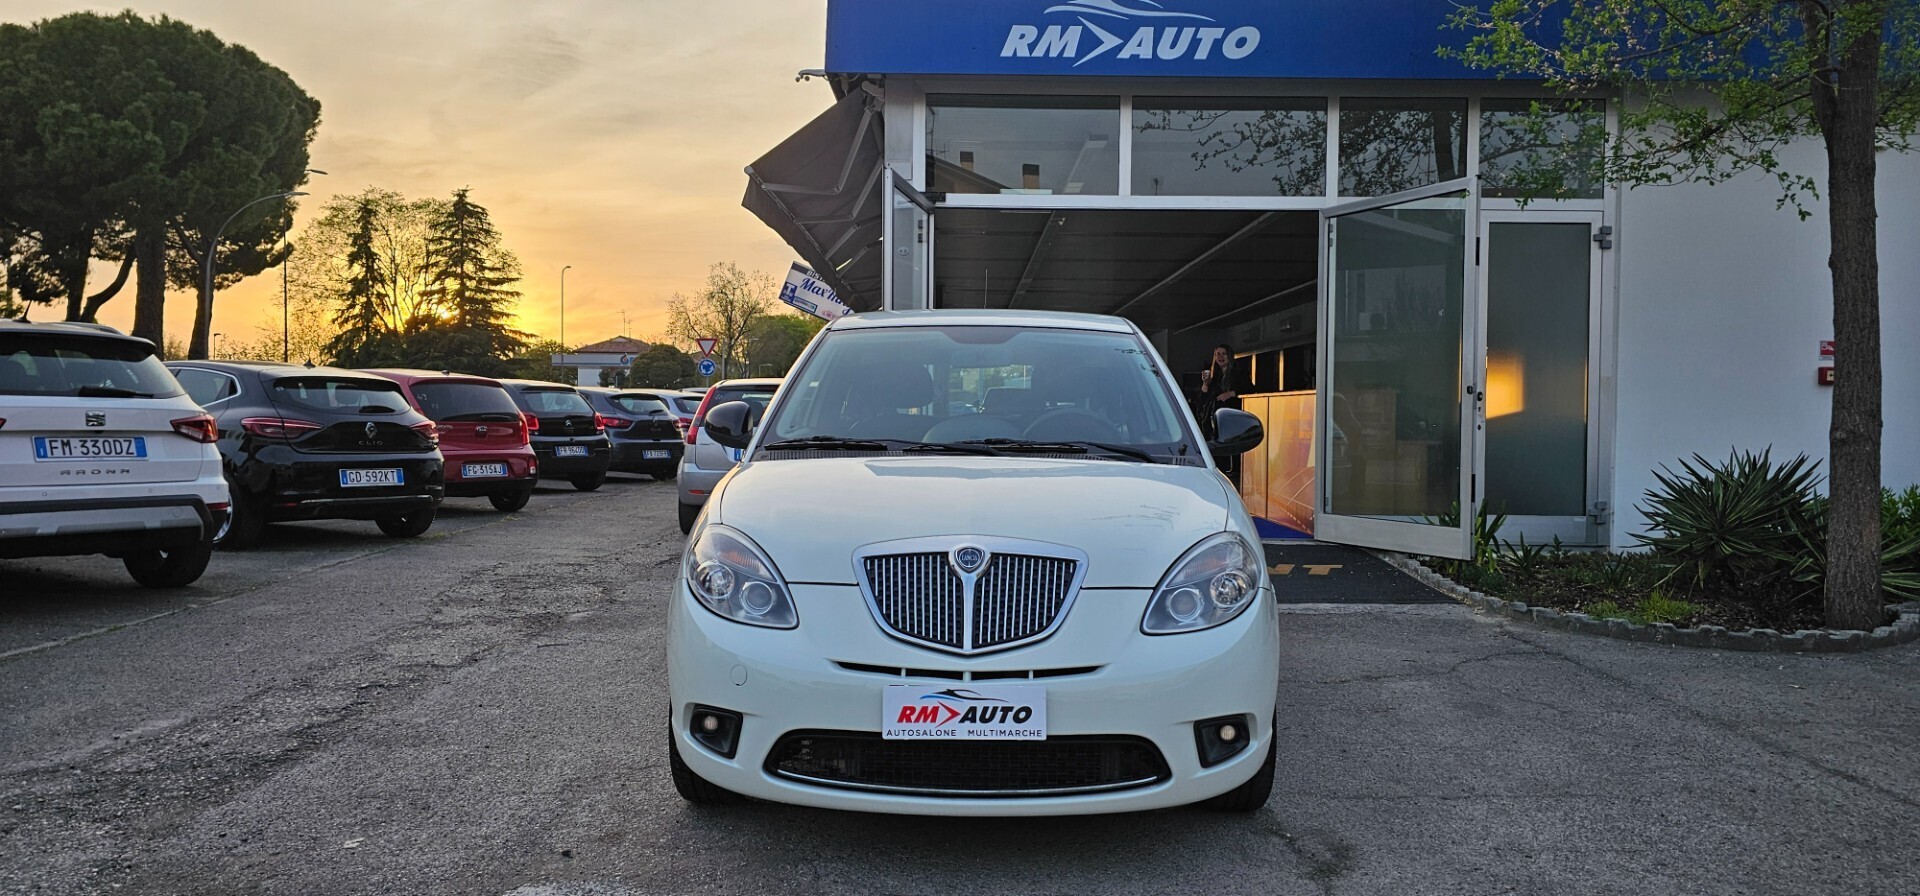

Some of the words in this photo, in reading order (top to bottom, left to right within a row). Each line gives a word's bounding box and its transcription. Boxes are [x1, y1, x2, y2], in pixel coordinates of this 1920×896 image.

[1000, 25, 1083, 58] RM
[1116, 26, 1261, 60] AUTO
[897, 705, 940, 724] RM
[958, 705, 1033, 724] AUTO
[886, 729, 957, 737] AUTOSALONE
[967, 729, 1043, 737] MULTIMARCHE
